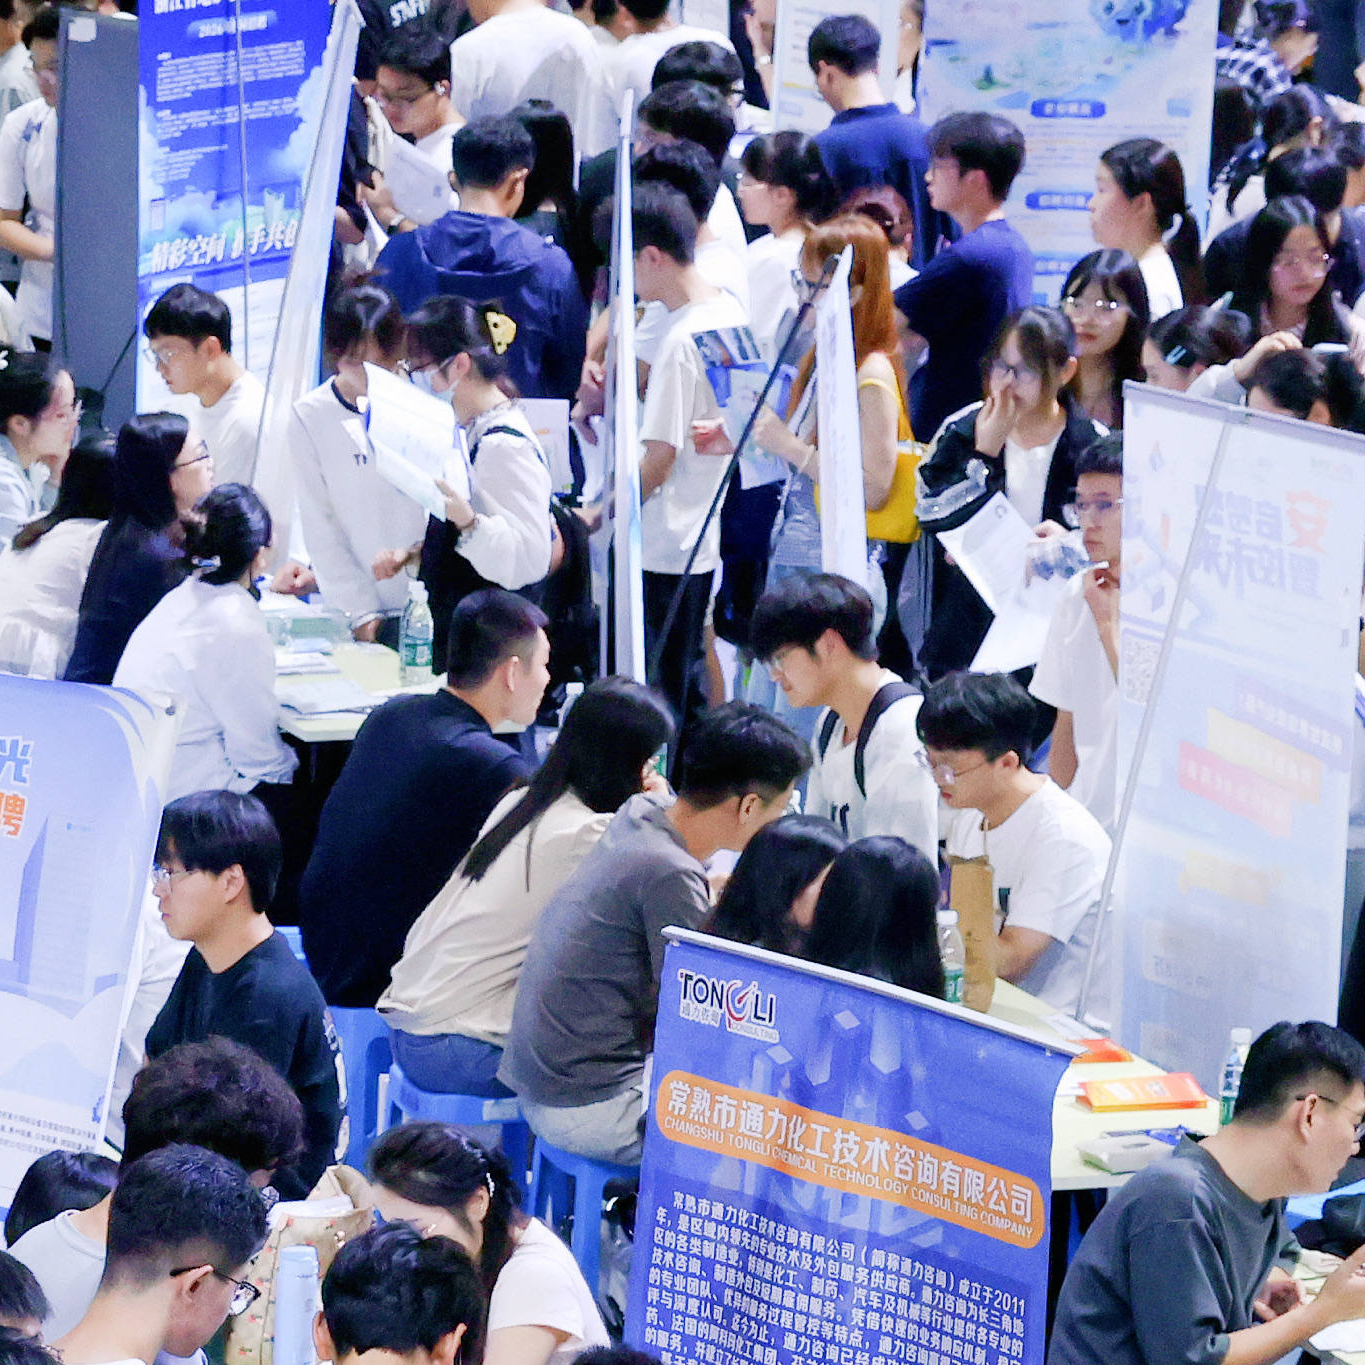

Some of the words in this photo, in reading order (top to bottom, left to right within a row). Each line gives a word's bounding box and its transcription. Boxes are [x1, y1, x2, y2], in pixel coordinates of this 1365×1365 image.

[679, 972, 775, 1024] TONGLI
[665, 1116, 724, 1144] CHANGSHU
[728, 1134, 771, 1157] TONGLI
[771, 1146, 818, 1173] CHEMICAL
[824, 1164, 910, 1195] TECHNOLOGY
[911, 1187, 978, 1221] CONSULTING
[980, 1211, 1033, 1239] COMPANY
[668, 1080, 1033, 1224] 常熟市通力化工技术咨询有限公司
